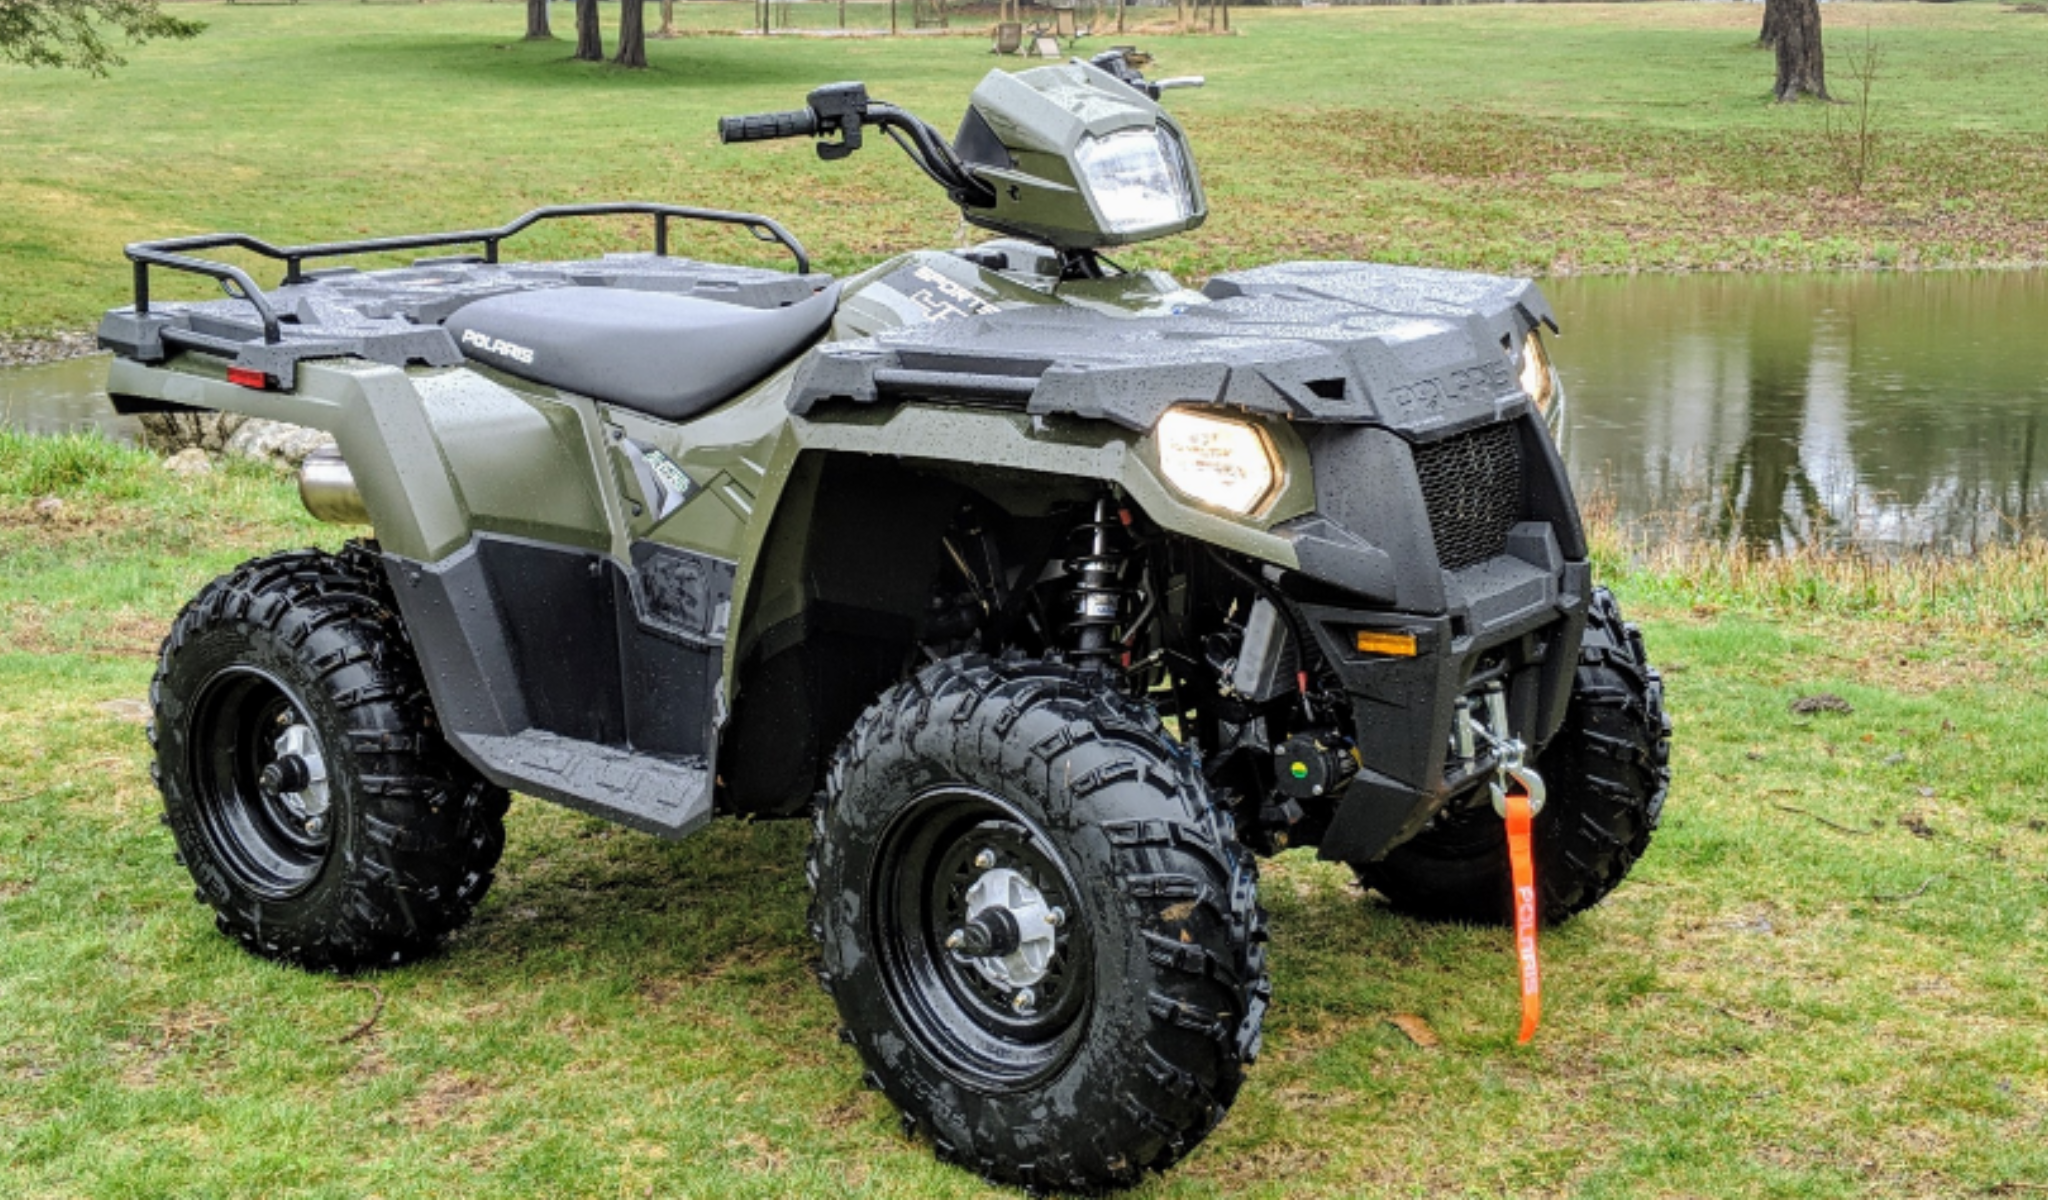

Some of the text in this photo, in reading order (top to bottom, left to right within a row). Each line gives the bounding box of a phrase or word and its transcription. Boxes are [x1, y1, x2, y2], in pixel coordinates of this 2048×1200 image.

[462, 328, 534, 365] POLARIS
[1388, 360, 1510, 410] POLARIS
[1518, 885, 1539, 995] POLARIS
